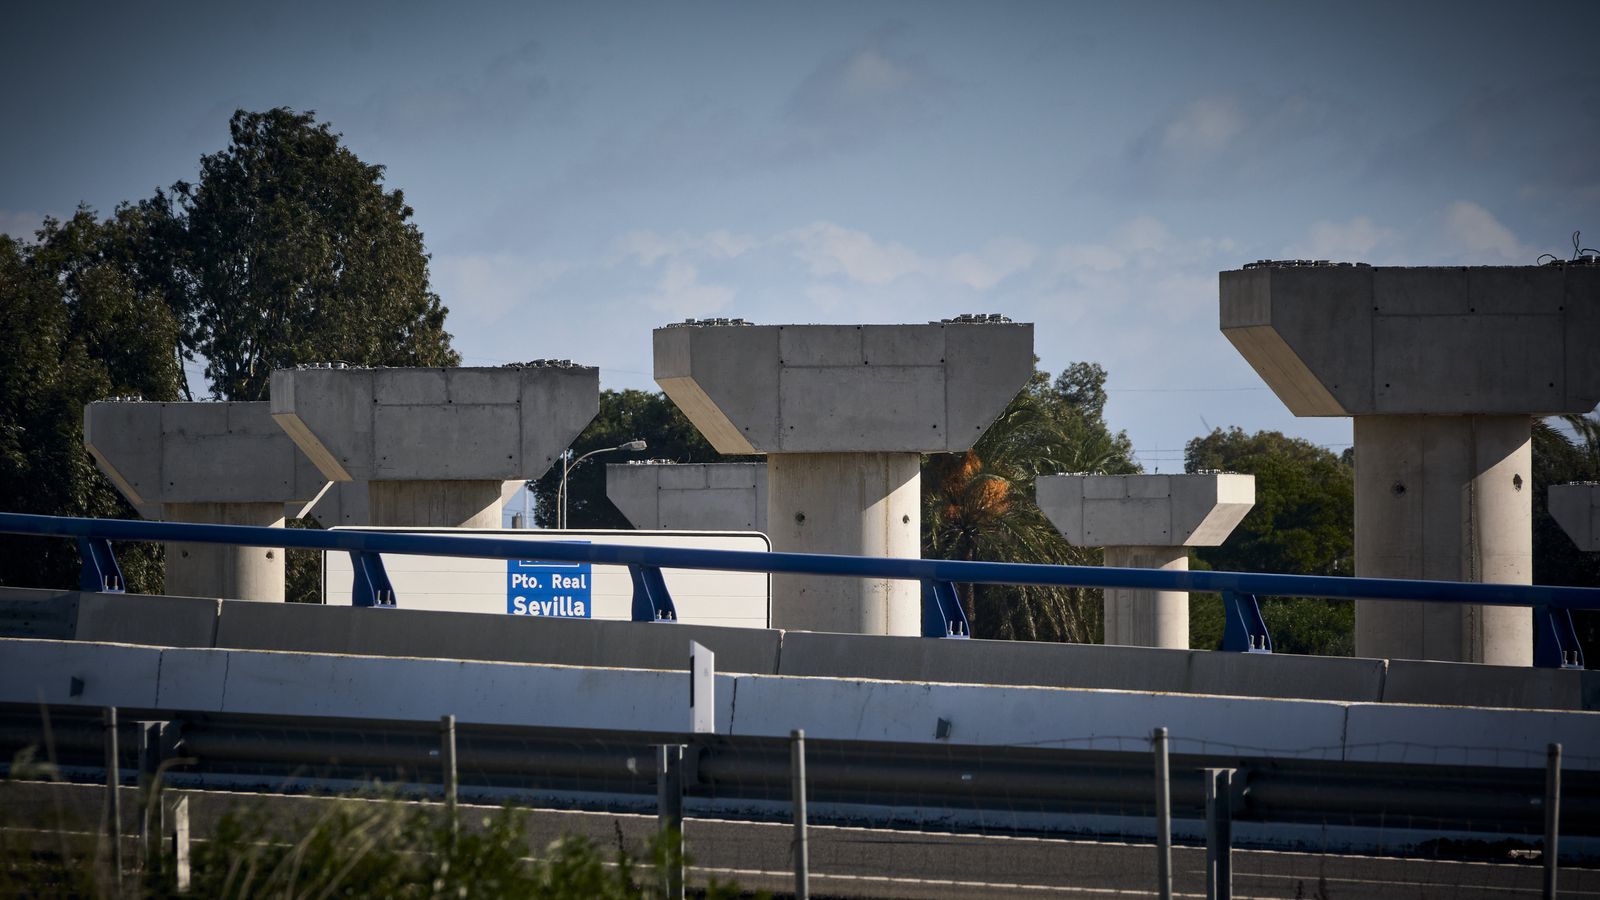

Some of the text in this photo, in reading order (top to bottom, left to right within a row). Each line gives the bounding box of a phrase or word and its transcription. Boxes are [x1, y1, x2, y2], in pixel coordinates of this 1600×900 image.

[512, 574, 586, 589] Pto. Real
[513, 596, 585, 616] Sevilla
